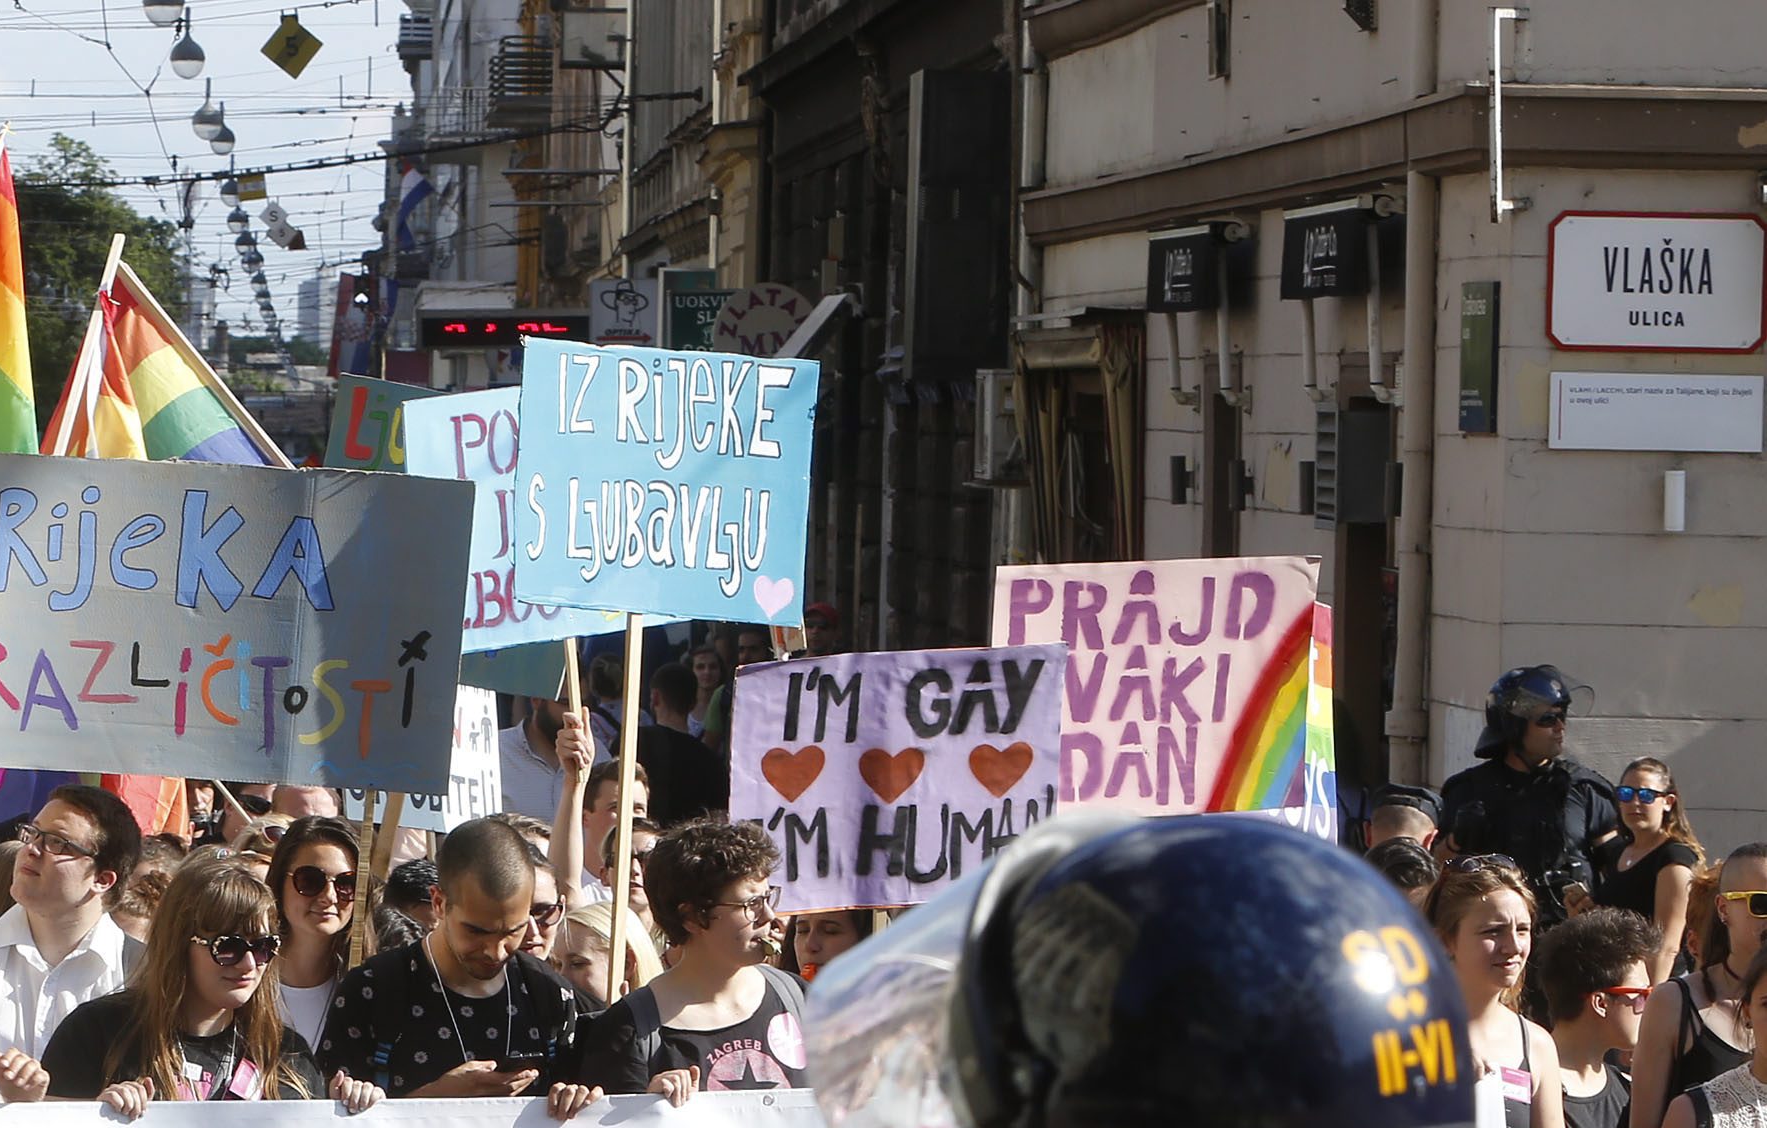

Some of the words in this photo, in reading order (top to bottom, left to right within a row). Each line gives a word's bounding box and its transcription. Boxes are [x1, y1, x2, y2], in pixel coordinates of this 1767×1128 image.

[1602, 238, 1714, 296] VLAŠKA
[1628, 310, 1686, 328] ULICA
[557, 353, 597, 434] IZ
[784, 666, 861, 743] I'M
[905, 659, 1044, 738] GAY
[706, 1038, 762, 1065] ZAGREB
[1372, 1018, 1457, 1097] II-VI
